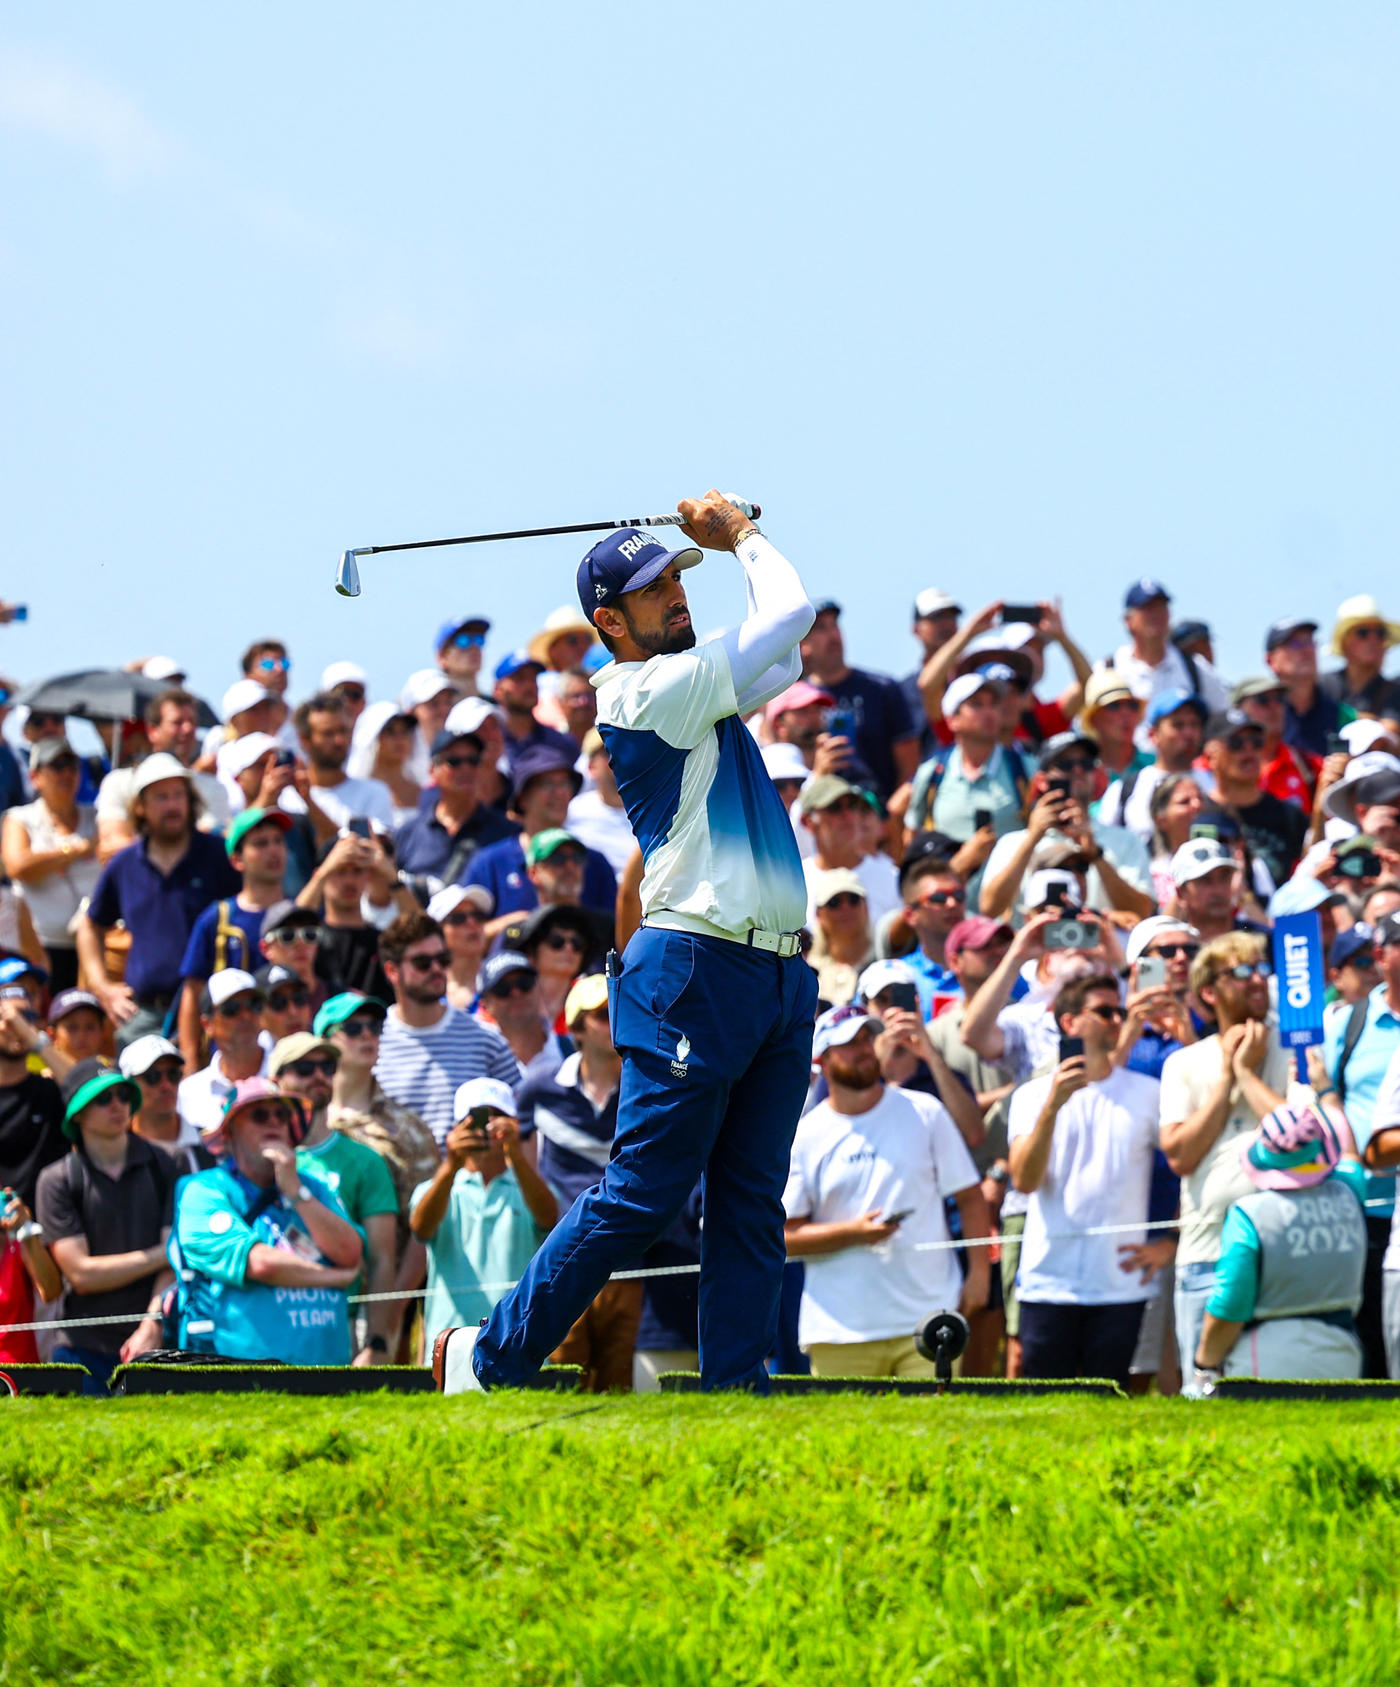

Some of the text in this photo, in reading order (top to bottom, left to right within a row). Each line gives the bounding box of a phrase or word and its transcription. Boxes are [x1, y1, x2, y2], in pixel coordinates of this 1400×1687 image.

[1284, 933, 1311, 1009] QUIET
[671, 1060, 688, 1070] FRANCE
[288, 1310, 337, 1328] TEAM
